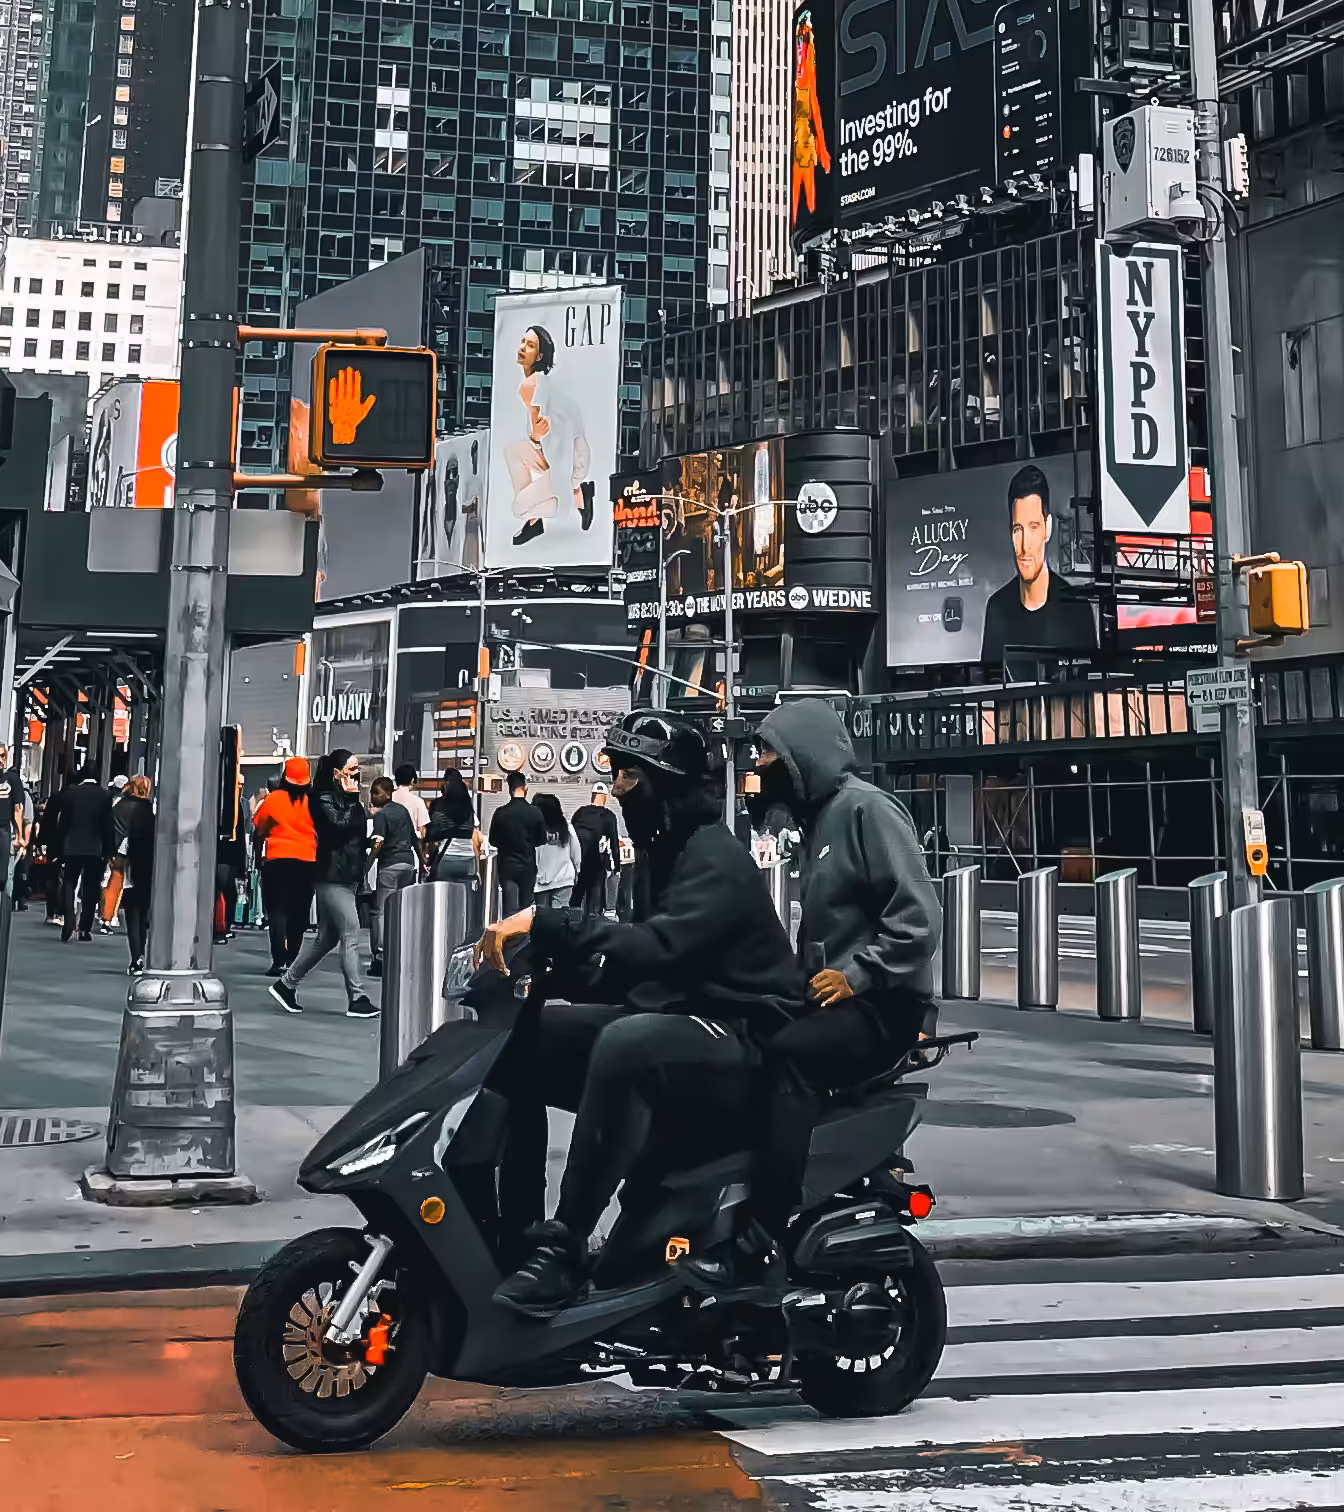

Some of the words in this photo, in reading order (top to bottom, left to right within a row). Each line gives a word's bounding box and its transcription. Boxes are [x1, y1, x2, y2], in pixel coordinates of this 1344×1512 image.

[840, 100, 920, 146] Investing
[923, 86, 952, 116] for
[839, 149, 870, 177] the
[872, 129, 918, 167] 99%.
[1154, 146, 1191, 164] 726152
[564, 303, 613, 349] GAP
[1124, 260, 1160, 462] NYPD
[798, 496, 834, 515] abc
[910, 526, 921, 546] A
[924, 519, 969, 544] LUCKY
[909, 545, 969, 575] Day
[696, 597, 710, 614] THE
[710, 592, 745, 613] WONER
[746, 590, 786, 609] YEARS
[812, 589, 872, 608] WEDNE
[312, 695, 336, 723] OLD
[337, 692, 372, 722] NAVY
